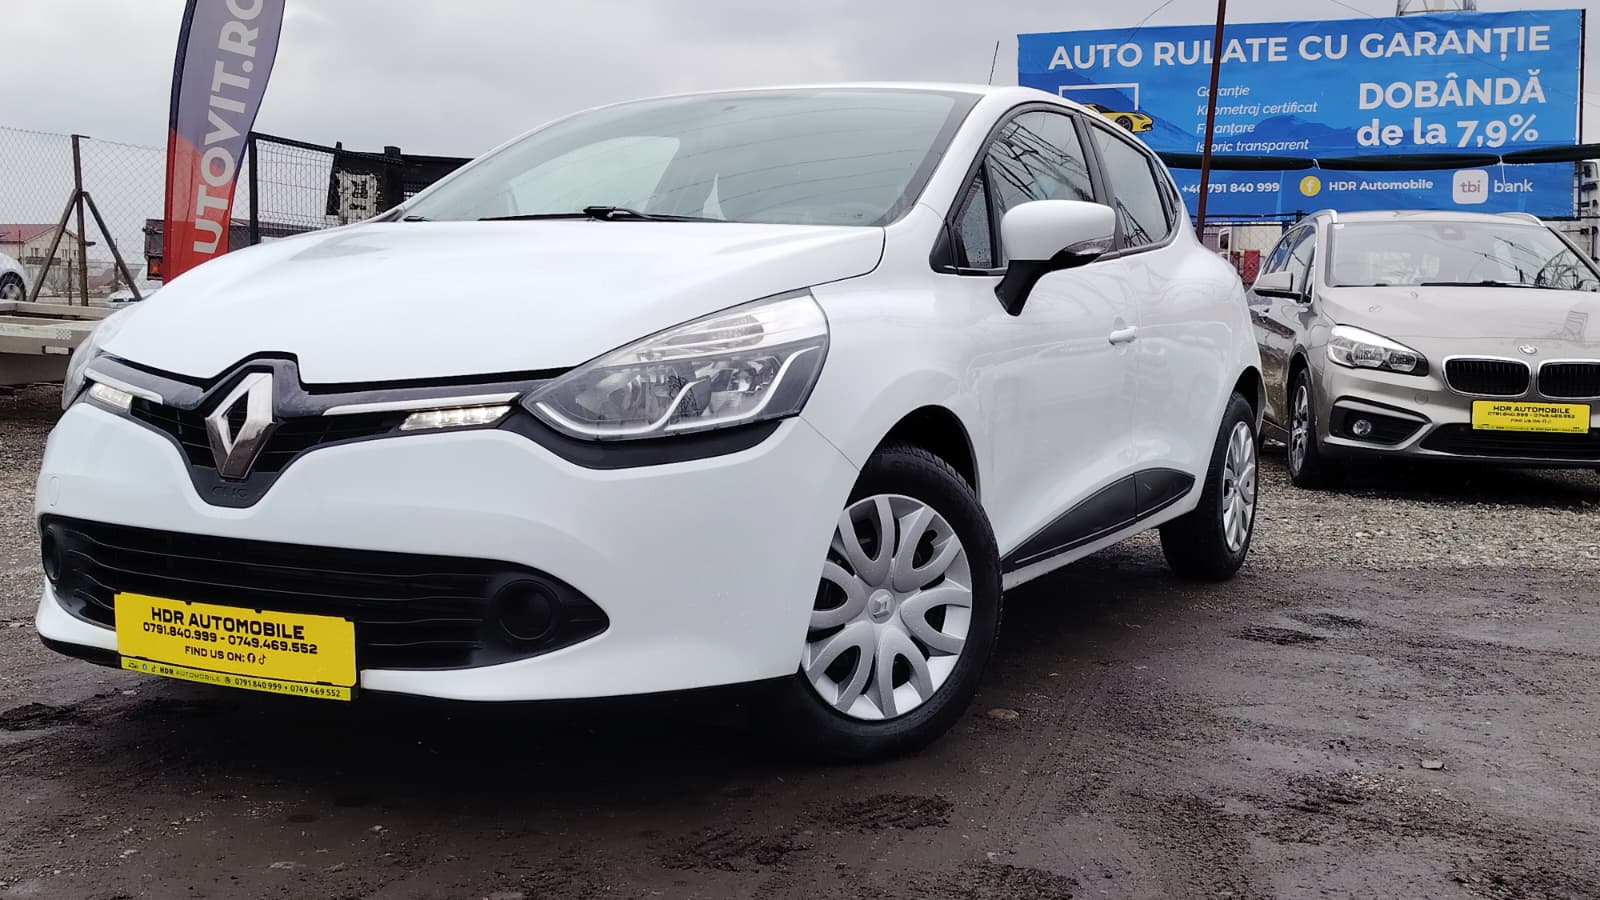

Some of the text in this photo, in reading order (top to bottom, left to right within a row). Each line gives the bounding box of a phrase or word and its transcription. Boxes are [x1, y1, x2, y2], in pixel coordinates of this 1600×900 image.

[1048, 26, 1551, 70] AUTO RULATE CU GARANȚIE
[1196, 85, 1250, 98] Ganție
[1359, 69, 1547, 110] DOBÂNDĂ
[1196, 101, 1318, 116] Kiometraj certificat
[1196, 123, 1255, 136] Fianțare
[1357, 114, 1540, 148] de la 7,9%
[1195, 139, 1310, 154] Isoric transparent
[1207, 183, 1227, 193] 791
[1230, 183, 1254, 193] 840
[1256, 182, 1280, 192] 999
[1328, 179, 1434, 192] HDR Automobile
[1460, 179, 1534, 194] tbi bank
[1514, 406, 1570, 414] AUTOMOBILE
[151, 607, 304, 640] HDR AUTOMOBILE
[143, 622, 217, 642] 0791.840.999
[228, 634, 318, 655] 0749.469.552
[185, 646, 245, 663] FIND US ON:
[268, 682, 282, 690] 999
[290, 684, 308, 693] 0749
[310, 687, 324, 695] 469
[326, 689, 341, 697] 552
